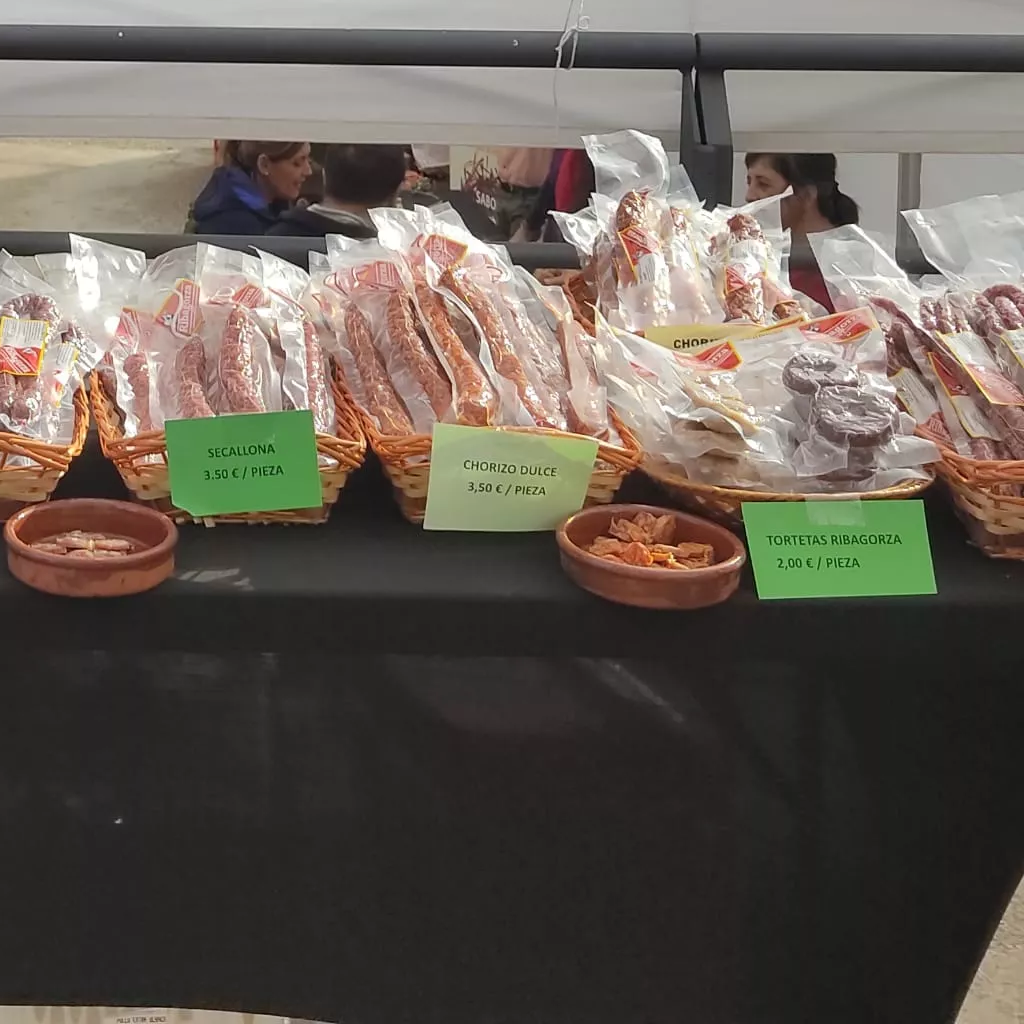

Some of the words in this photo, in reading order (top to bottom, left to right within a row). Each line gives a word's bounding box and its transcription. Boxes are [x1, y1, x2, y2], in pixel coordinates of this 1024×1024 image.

[207, 443, 276, 458] SECALLONA
[203, 468, 228, 480] 3.50
[231, 467, 239, 478] €
[242, 466, 248, 480] /
[251, 465, 284, 478] PIEZA
[463, 459, 516, 474] CHORIZO
[520, 465, 557, 477] DULCE
[467, 481, 492, 493] 3,50
[495, 484, 503, 494] €
[504, 484, 512, 496] /
[514, 485, 546, 496] PIEZA
[766, 534, 828, 546] TORTETAS
[831, 534, 902, 545] RIBAGORZA
[776, 557, 802, 571] 2,00
[806, 557, 813, 568] €
[816, 556, 822, 571] /
[826, 557, 860, 568] PIEZA
